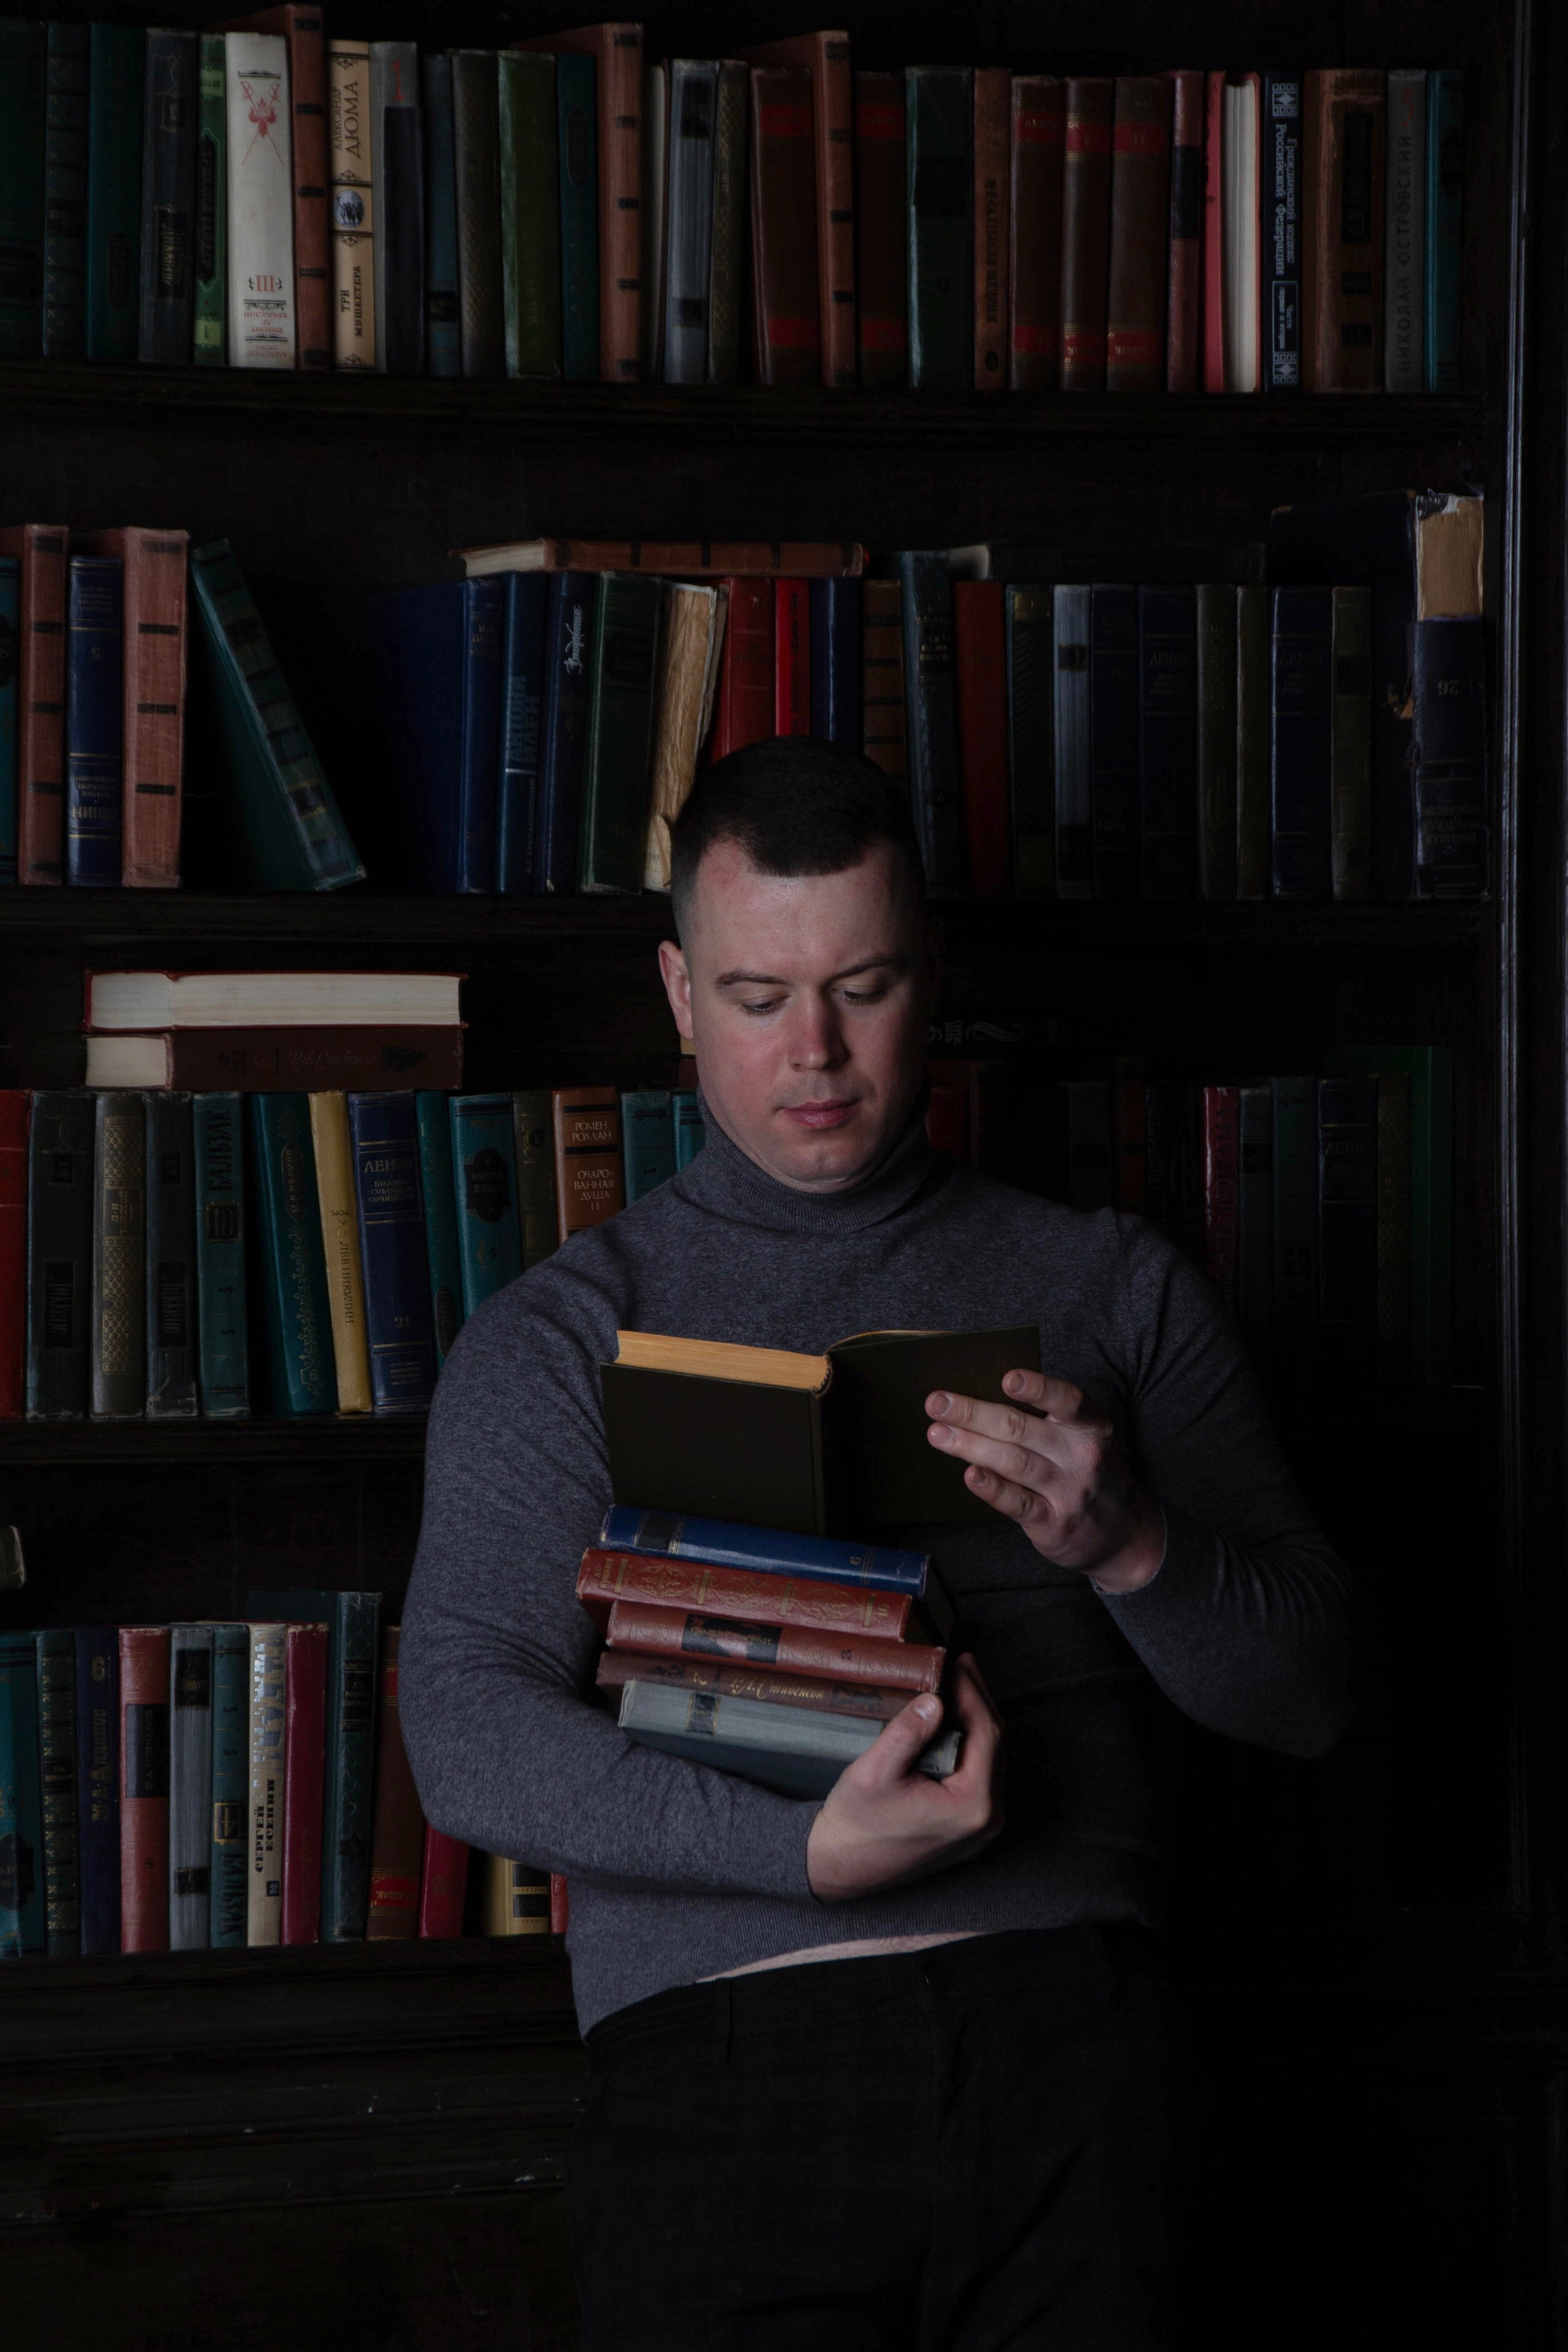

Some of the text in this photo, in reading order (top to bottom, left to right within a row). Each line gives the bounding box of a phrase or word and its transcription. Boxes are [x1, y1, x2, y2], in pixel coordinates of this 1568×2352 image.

[332, 86, 342, 150] АЛЕКСАНДР
[344, 81, 362, 159] ДЮМА
[1274, 123, 1287, 276] Российской Федерации
[1285, 138, 1297, 263] Гражданский кодекс
[1396, 134, 1412, 372] НИКОЛАЙ ОСТРОВСКИЙ
[341, 289, 350, 312] ТРИ
[353, 266, 363, 337] МУШКЕТЕРА
[1278, 286, 1286, 313] первая
[1438, 680, 1459, 696] 26
[510, 676, 527, 763] АНТОНИ
[572, 1131, 611, 1142] РОЛЛАН
[575, 1121, 608, 1131] РОМЕН
[206, 1109, 233, 1191] БАЛЬЗАК
[364, 1158, 416, 1173] ЛЕНИН
[573, 1179, 614, 1190] ВАННАЯ
[577, 1169, 614, 1180] ОЧАРО-
[580, 1191, 611, 1201] ДУША
[212, 1207, 238, 1239] 10
[340, 1242, 349, 1265] ЛЕВ
[341, 1267, 354, 1324] НИКУЛИН
[394, 1316, 411, 1328] 21
[265, 1778, 275, 1852] ЕСЕНИН
[254, 1804, 265, 1873] СЕРГЕЙ
[219, 1853, 245, 1937] БАЛЬЗАК
